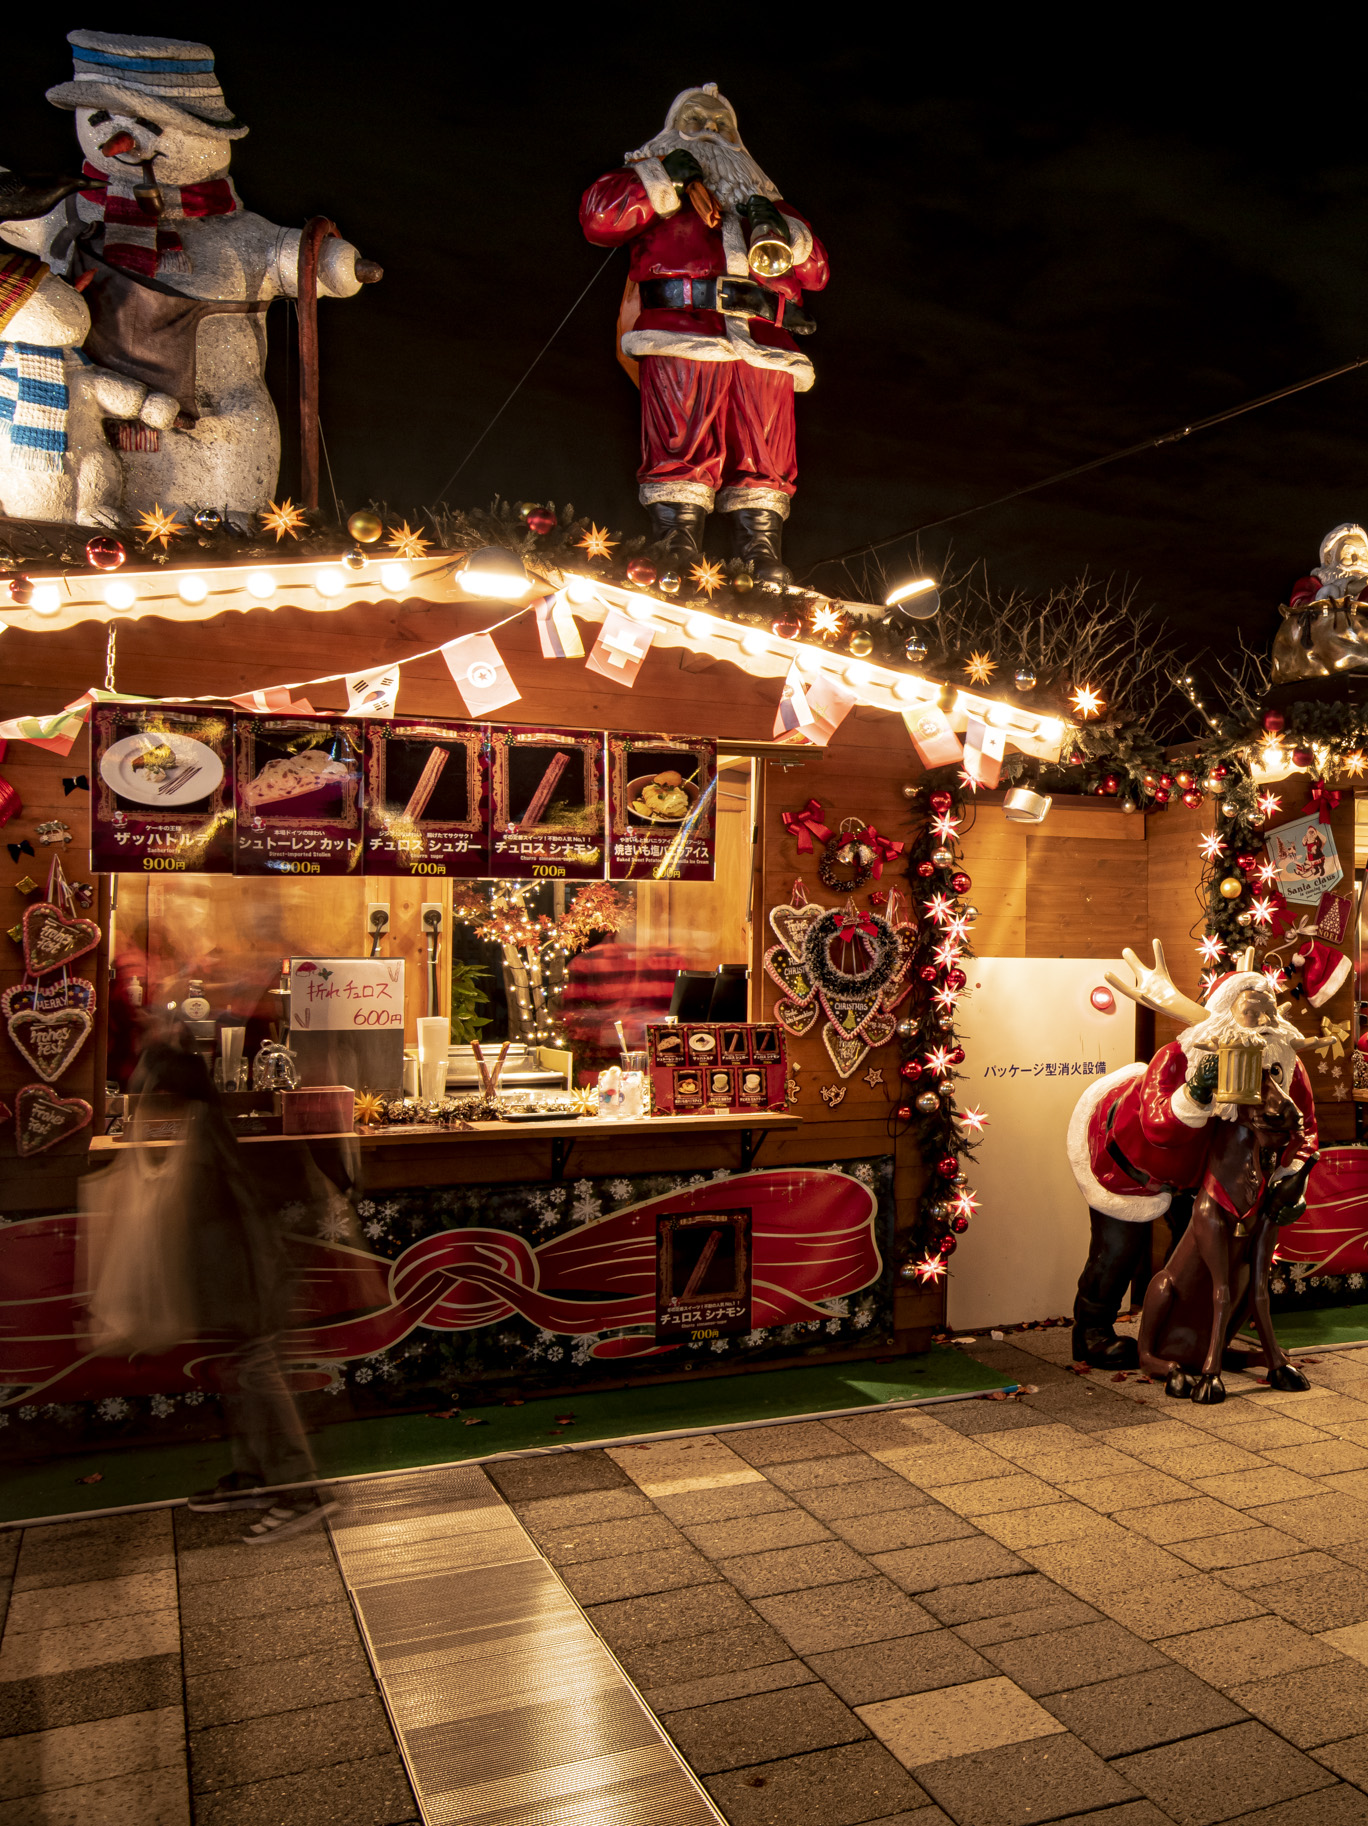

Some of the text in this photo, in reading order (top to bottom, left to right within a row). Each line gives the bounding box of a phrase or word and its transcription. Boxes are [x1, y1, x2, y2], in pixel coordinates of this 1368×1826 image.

[114, 831, 210, 847] ザッハトルテ
[239, 836, 358, 851] シュトーレン カット
[369, 838, 482, 853] チュロス シュガー
[494, 841, 599, 855] チュロス シナモン
[143, 857, 186, 871] 900円
[281, 861, 321, 874] 900円
[409, 862, 446, 875] 700円
[532, 864, 566, 877] 700円
[1286, 882, 1312, 896] Santa
[306, 979, 393, 1002] 折れチュロス
[353, 1008, 402, 1026] 600円
[30, 1025, 71, 1044] Frohes
[37, 1040, 66, 1057] Fest
[984, 1061, 1107, 1078] パッケージ型消火設備
[660, 1306, 746, 1326] チュロス シナモン
[690, 1328, 720, 1341] 700円
